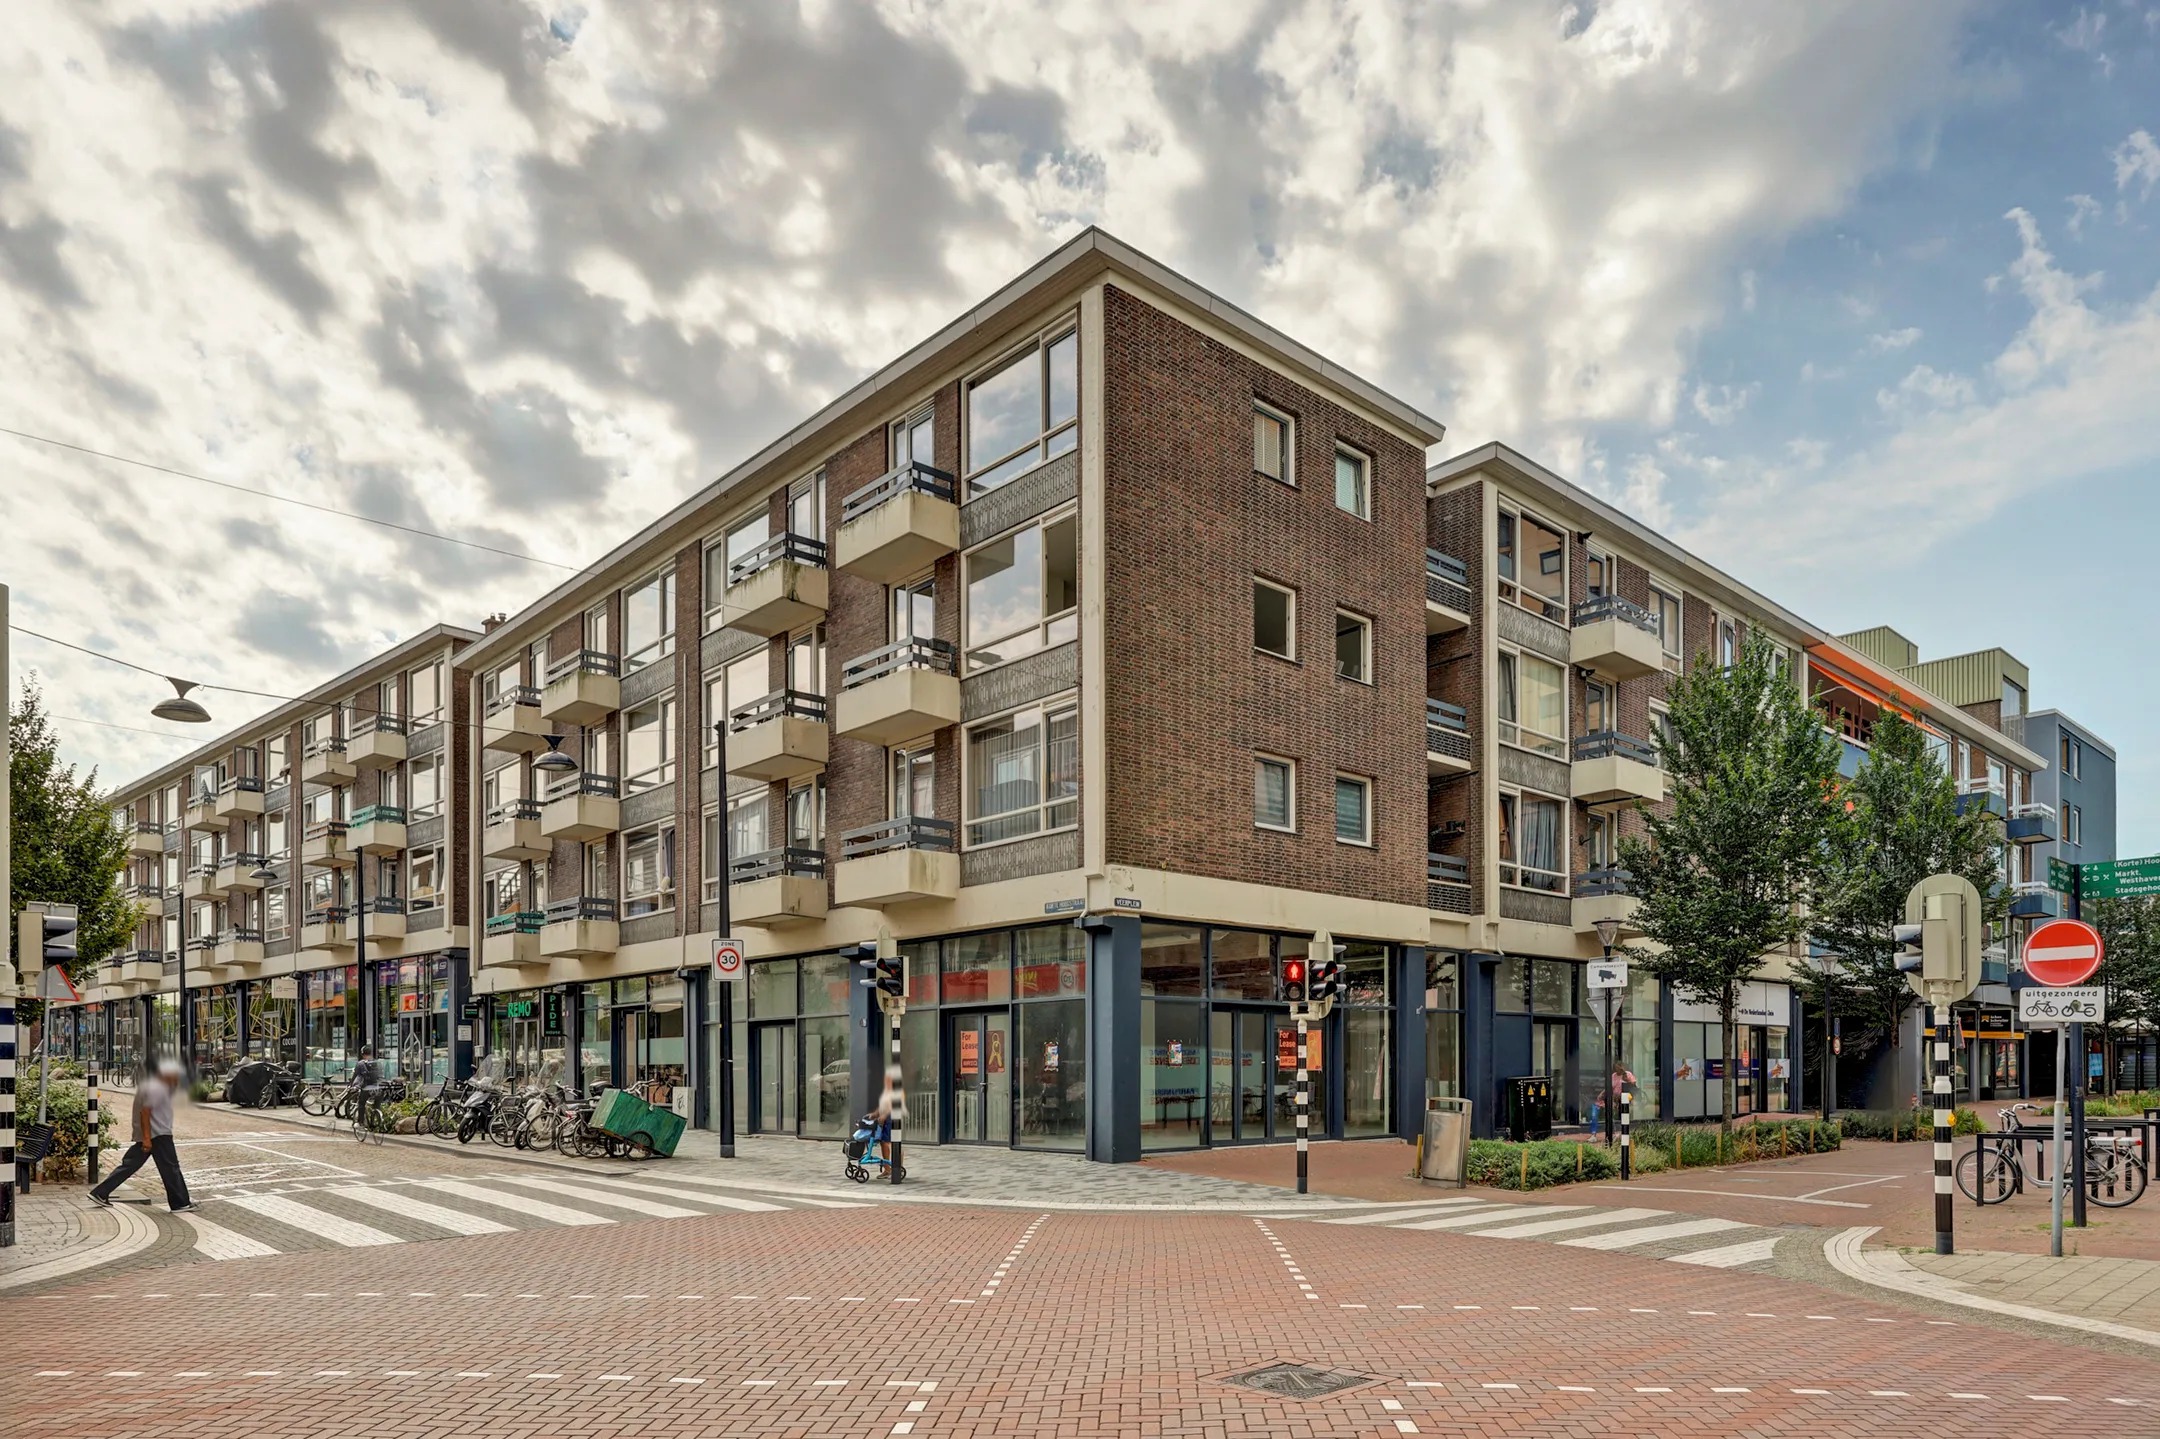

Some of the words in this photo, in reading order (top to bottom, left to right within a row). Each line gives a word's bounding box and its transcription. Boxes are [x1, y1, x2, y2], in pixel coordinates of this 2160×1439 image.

[1116, 899, 1140, 907] VEERPLEIN
[721, 955, 736, 964] 30
[2026, 990, 2098, 998] uitgezonderd
[507, 1001, 531, 1017] REMO
